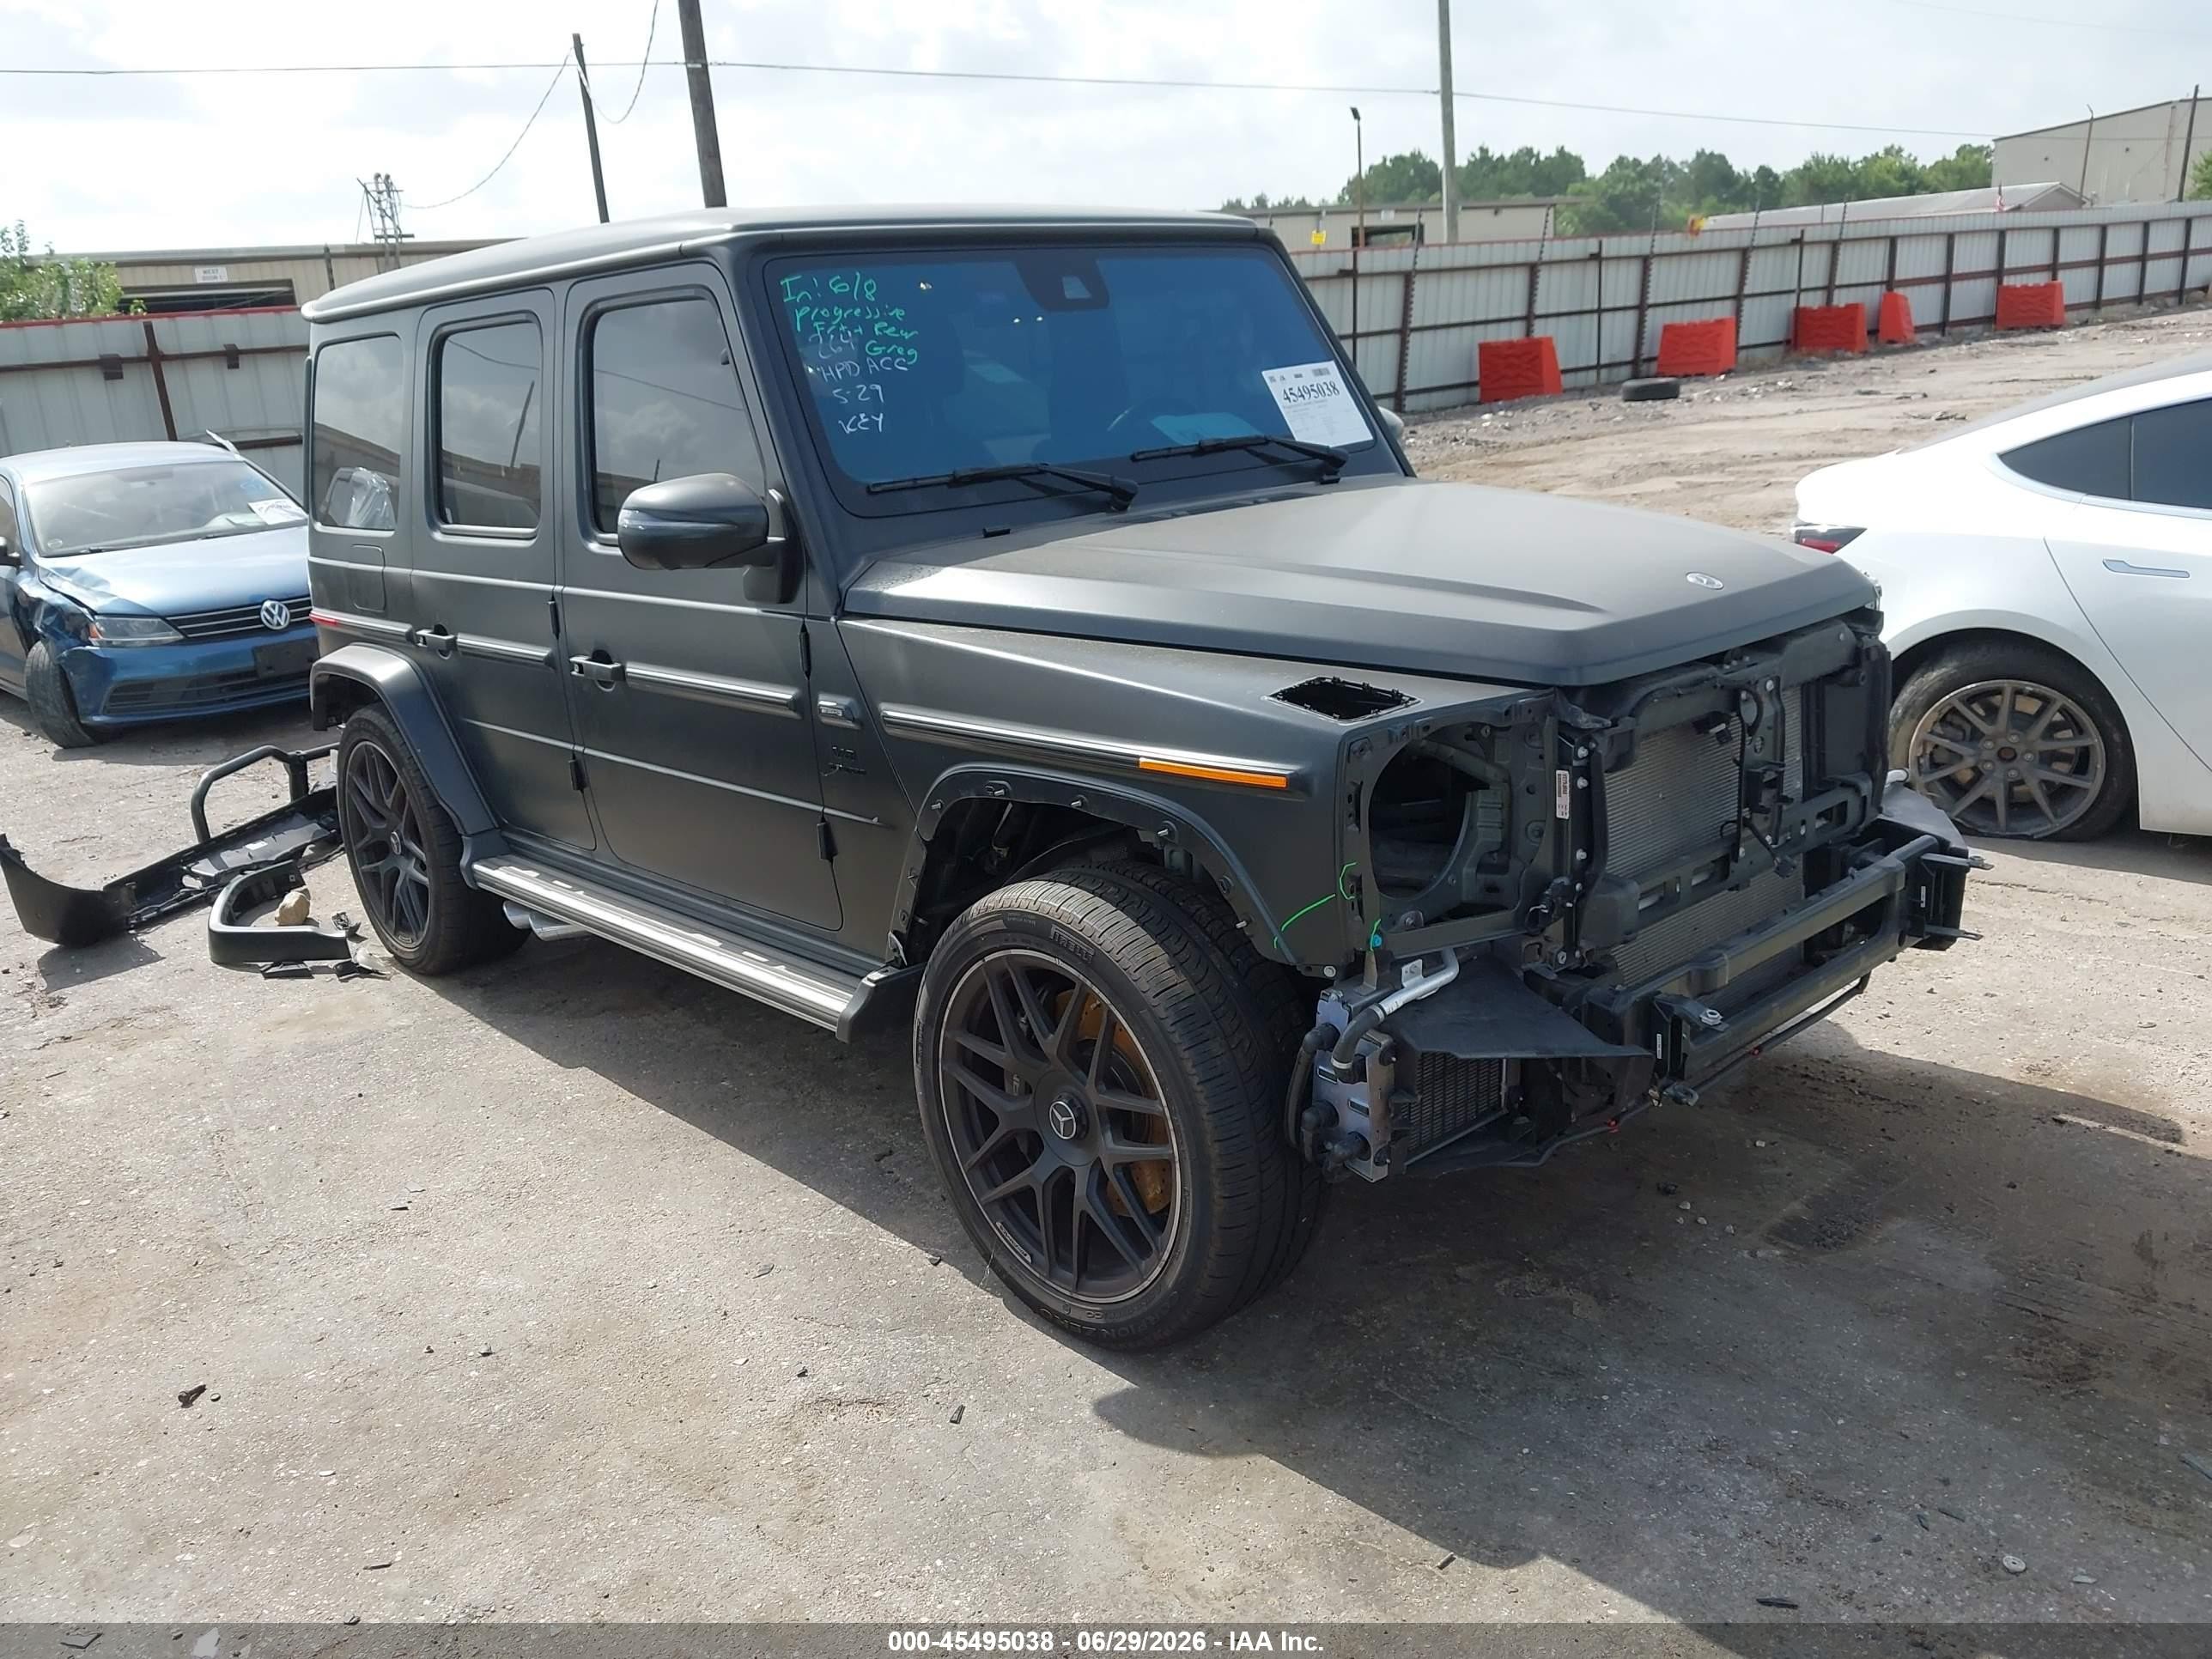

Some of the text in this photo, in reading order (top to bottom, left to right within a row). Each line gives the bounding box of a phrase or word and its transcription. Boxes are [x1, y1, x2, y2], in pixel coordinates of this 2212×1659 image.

[865, 340, 917, 364] Greg
[866, 356, 908, 374] ACC
[1283, 381, 1340, 403] 45495038
[838, 413, 884, 434] KEY
